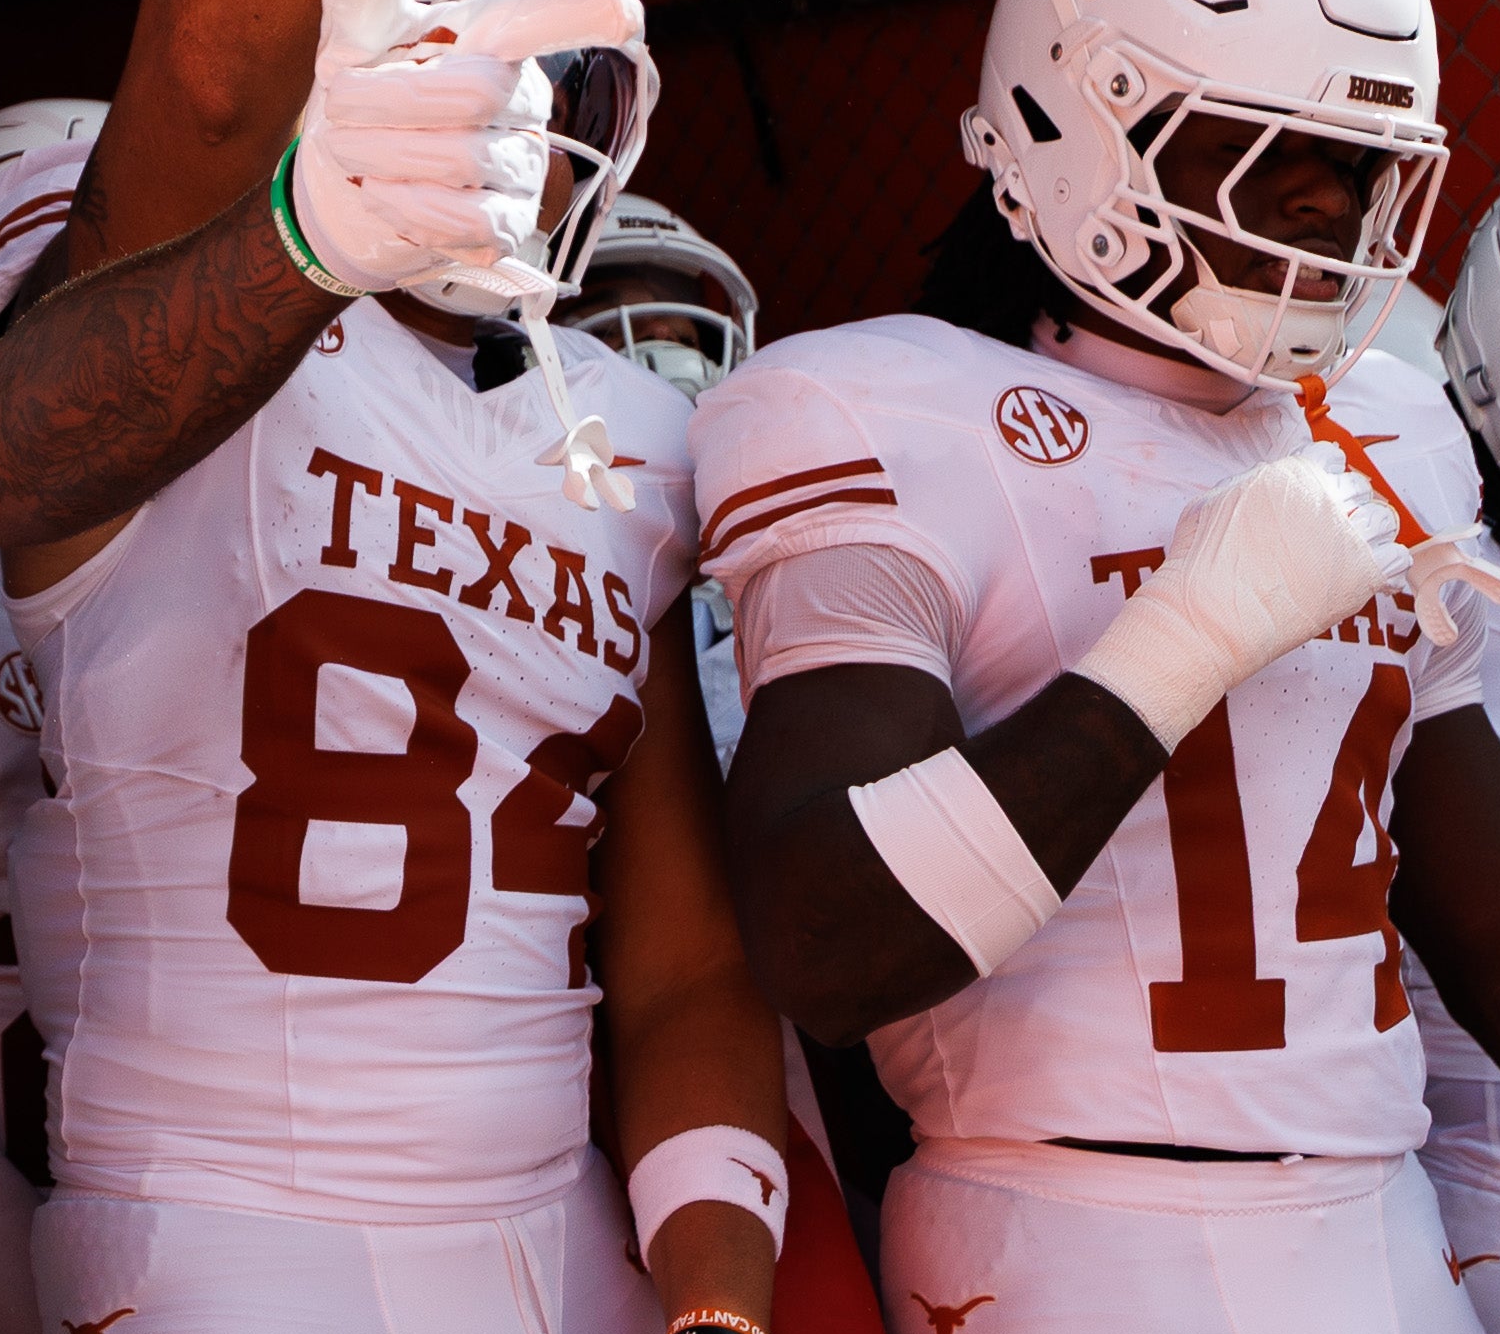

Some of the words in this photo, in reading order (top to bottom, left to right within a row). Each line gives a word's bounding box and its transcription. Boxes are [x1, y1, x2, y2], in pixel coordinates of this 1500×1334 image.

[1347, 75, 1415, 109] HORNS
[309, 269, 335, 290] TAKE
[1000, 389, 1084, 461] SEC
[306, 447, 643, 678] TEXAS
[1149, 663, 1412, 1053] 14
[698, 1309, 751, 1332] CAN'T
